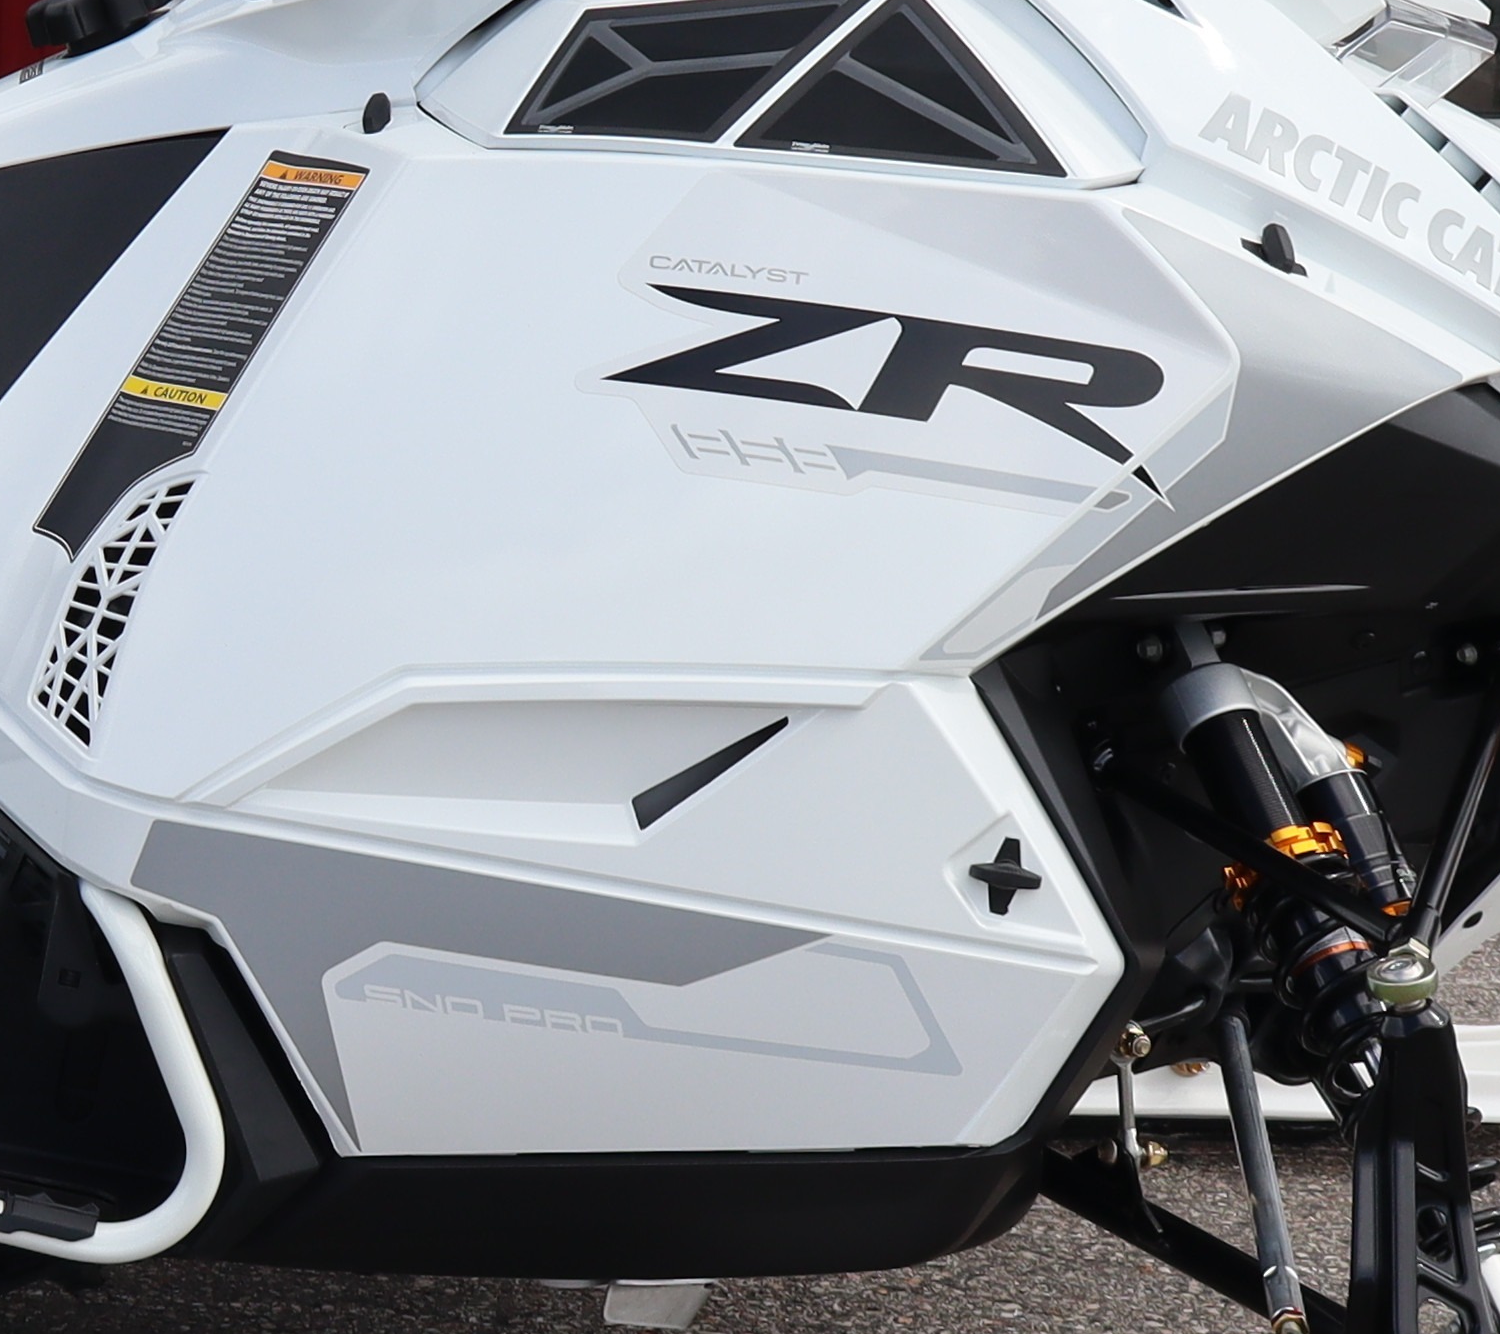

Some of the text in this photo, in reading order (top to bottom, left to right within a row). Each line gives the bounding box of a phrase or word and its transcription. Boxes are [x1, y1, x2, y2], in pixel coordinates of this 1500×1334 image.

[294, 170, 345, 185] WARNING
[1198, 92, 1420, 240] ARCTIC
[648, 254, 809, 285] CATALYST
[153, 386, 208, 404] CAUTION
[600, 282, 1175, 512] ZR
[364, 984, 624, 1039] SNO PRO
